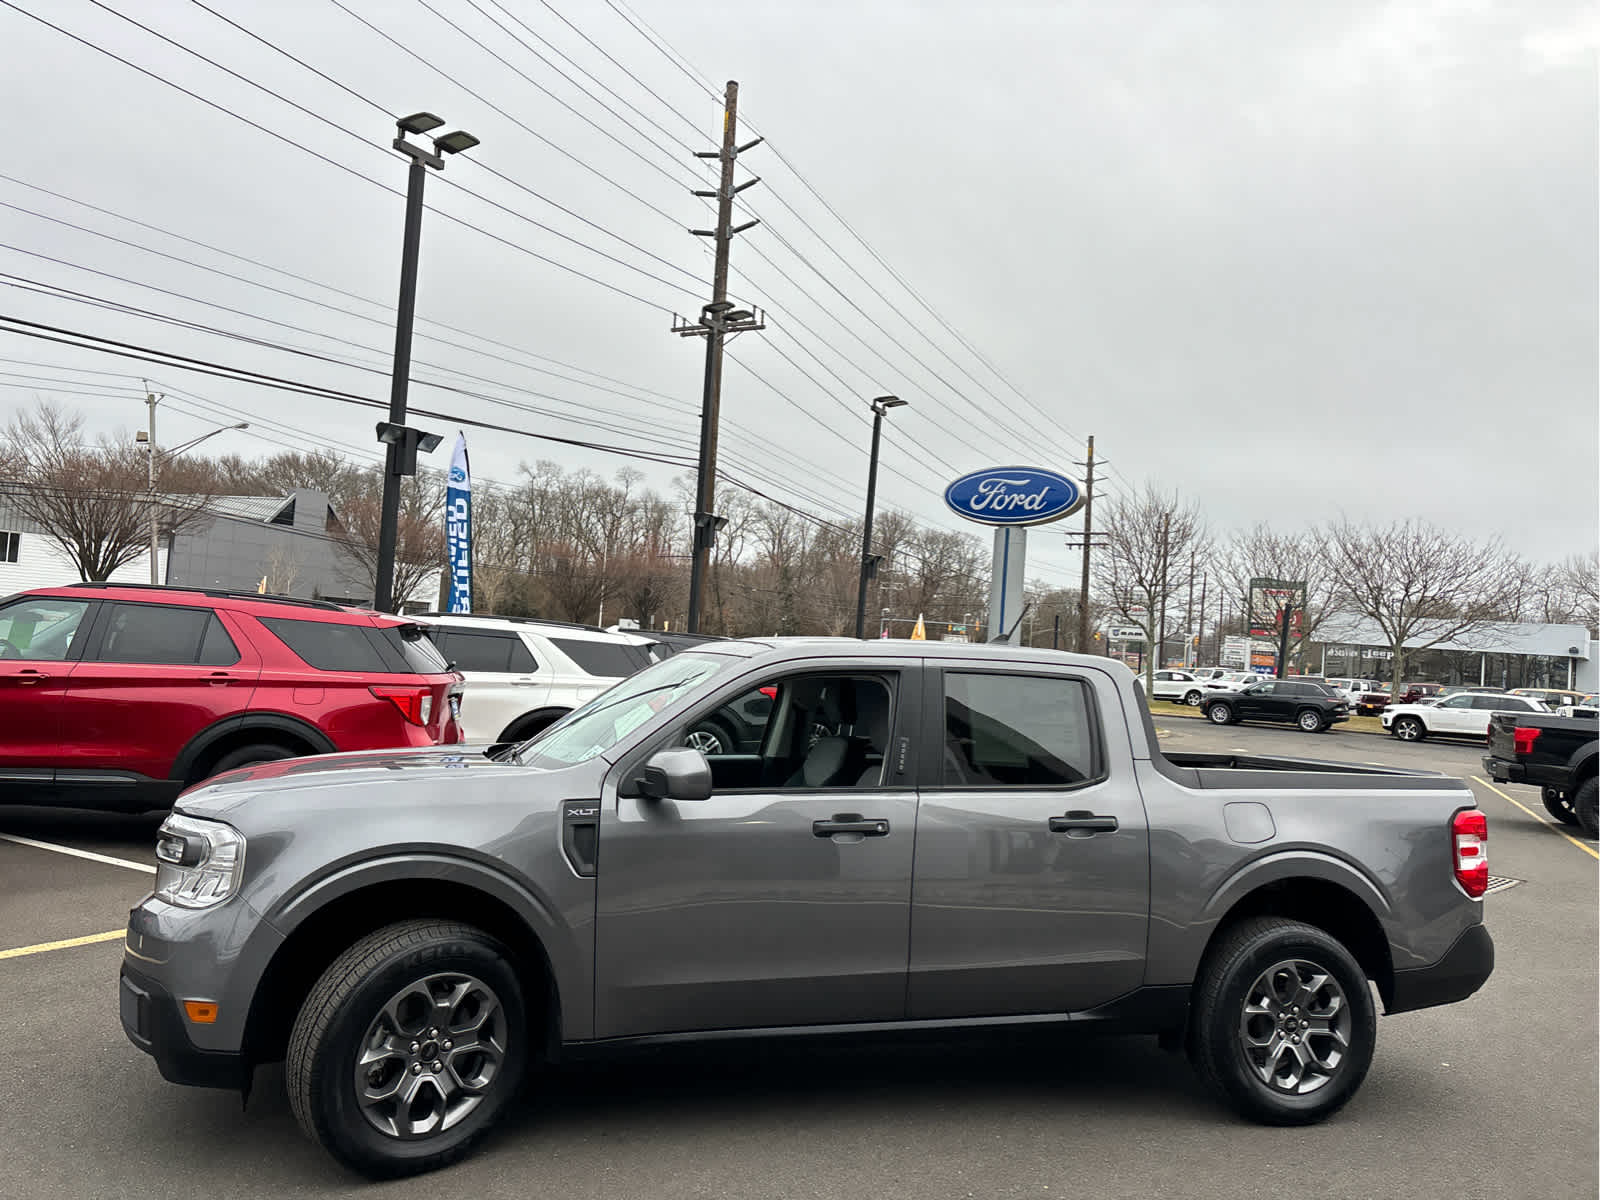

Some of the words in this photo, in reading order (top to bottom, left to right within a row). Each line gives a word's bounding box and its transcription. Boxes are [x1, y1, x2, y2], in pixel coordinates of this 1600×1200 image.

[970, 478, 1050, 511] Ford
[1361, 648, 1395, 660] Jeep
[567, 808, 600, 817] XLT
